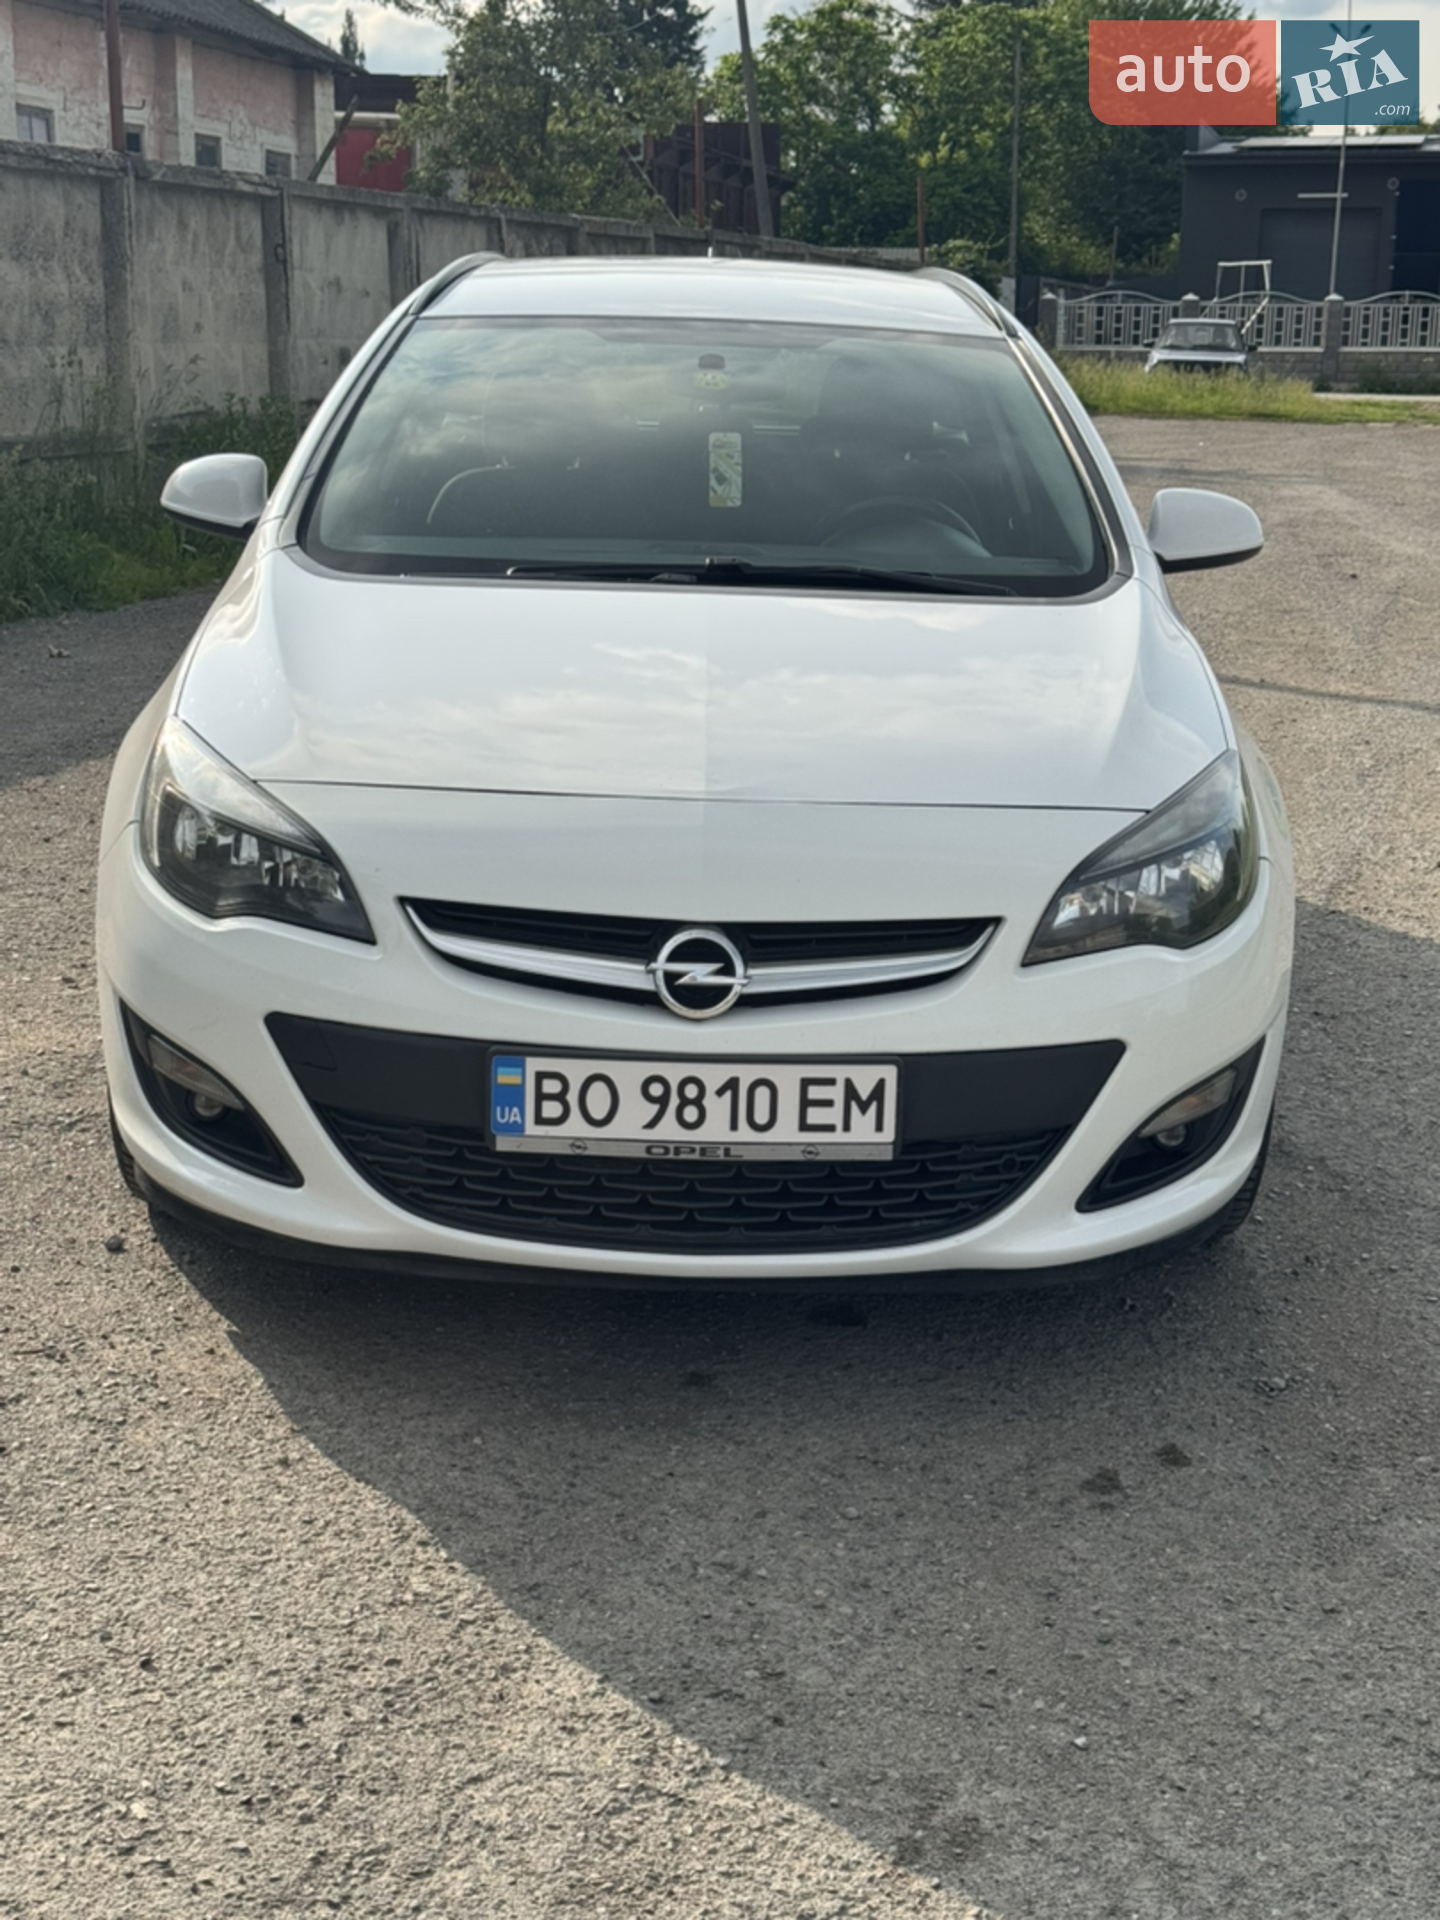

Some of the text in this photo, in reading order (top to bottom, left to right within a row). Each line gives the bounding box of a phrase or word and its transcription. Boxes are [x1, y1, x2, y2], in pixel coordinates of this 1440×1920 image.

[533, 1070, 887, 1134] BO 9810 EM
[496, 1106, 522, 1124] UA
[644, 1144, 744, 1158] OPEL
